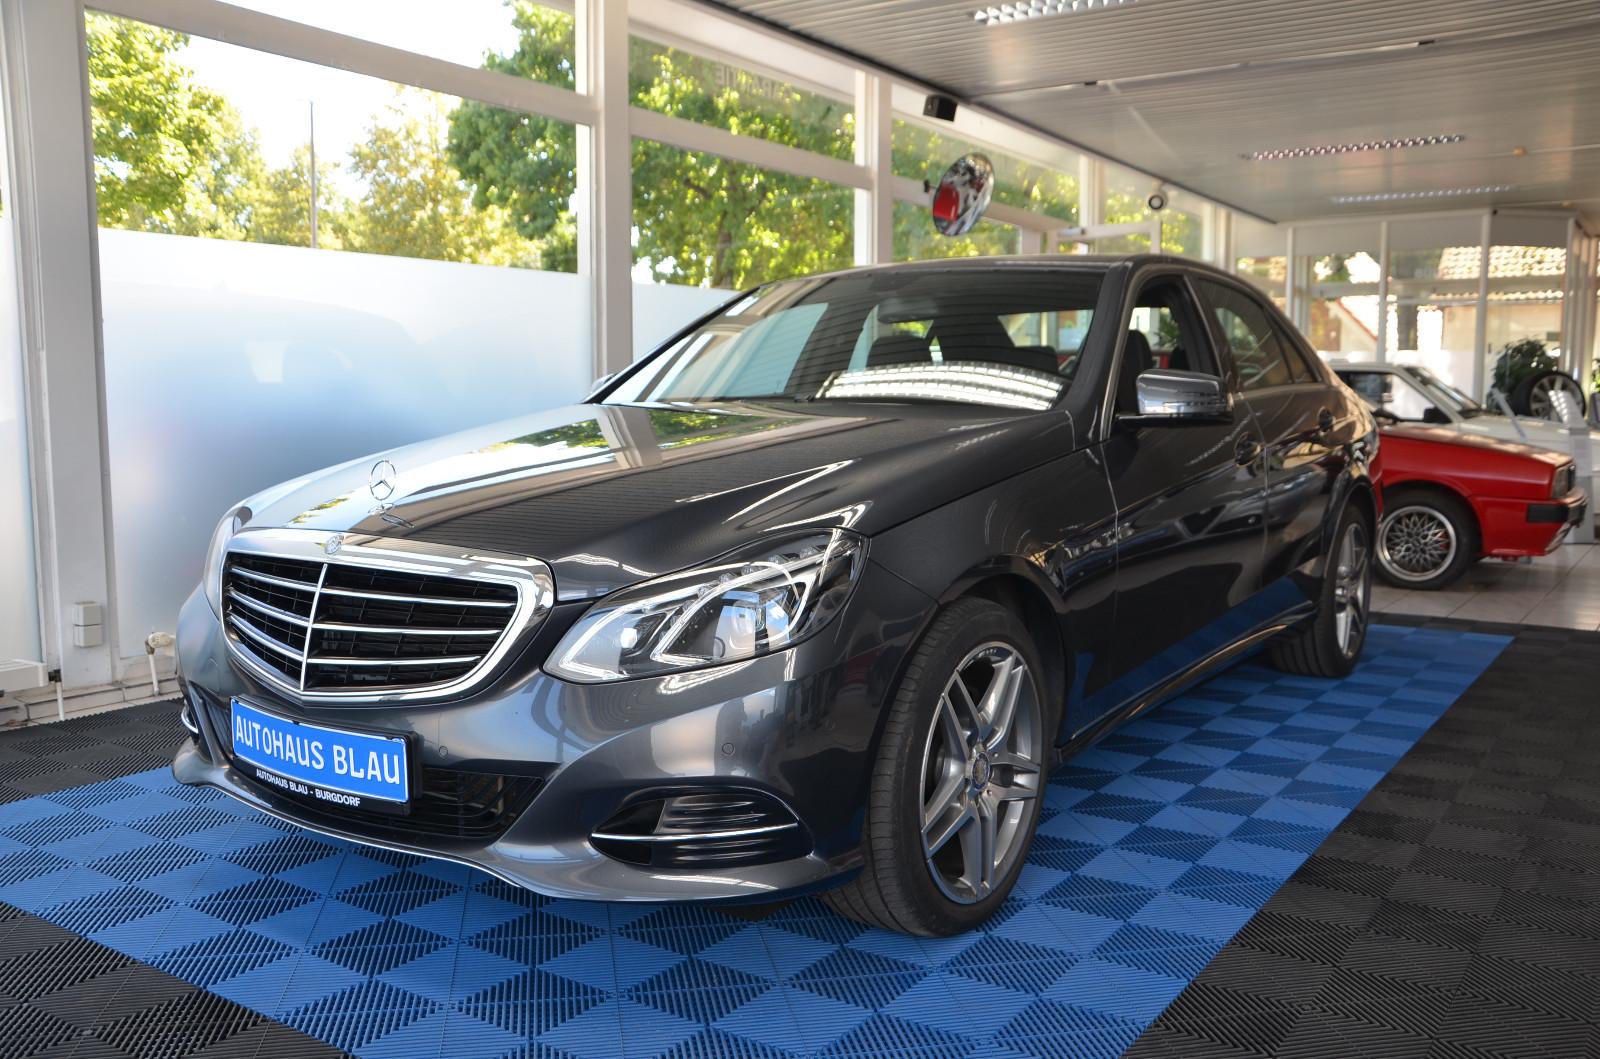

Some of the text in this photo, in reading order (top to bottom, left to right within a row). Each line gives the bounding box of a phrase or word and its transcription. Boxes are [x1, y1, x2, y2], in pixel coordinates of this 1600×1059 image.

[236, 715, 400, 785] AUTOHAUS BLAU
[256, 769, 288, 789] AUTOHAUS
[289, 781, 308, 795] BLAU
[315, 789, 361, 807] BURGDORF
